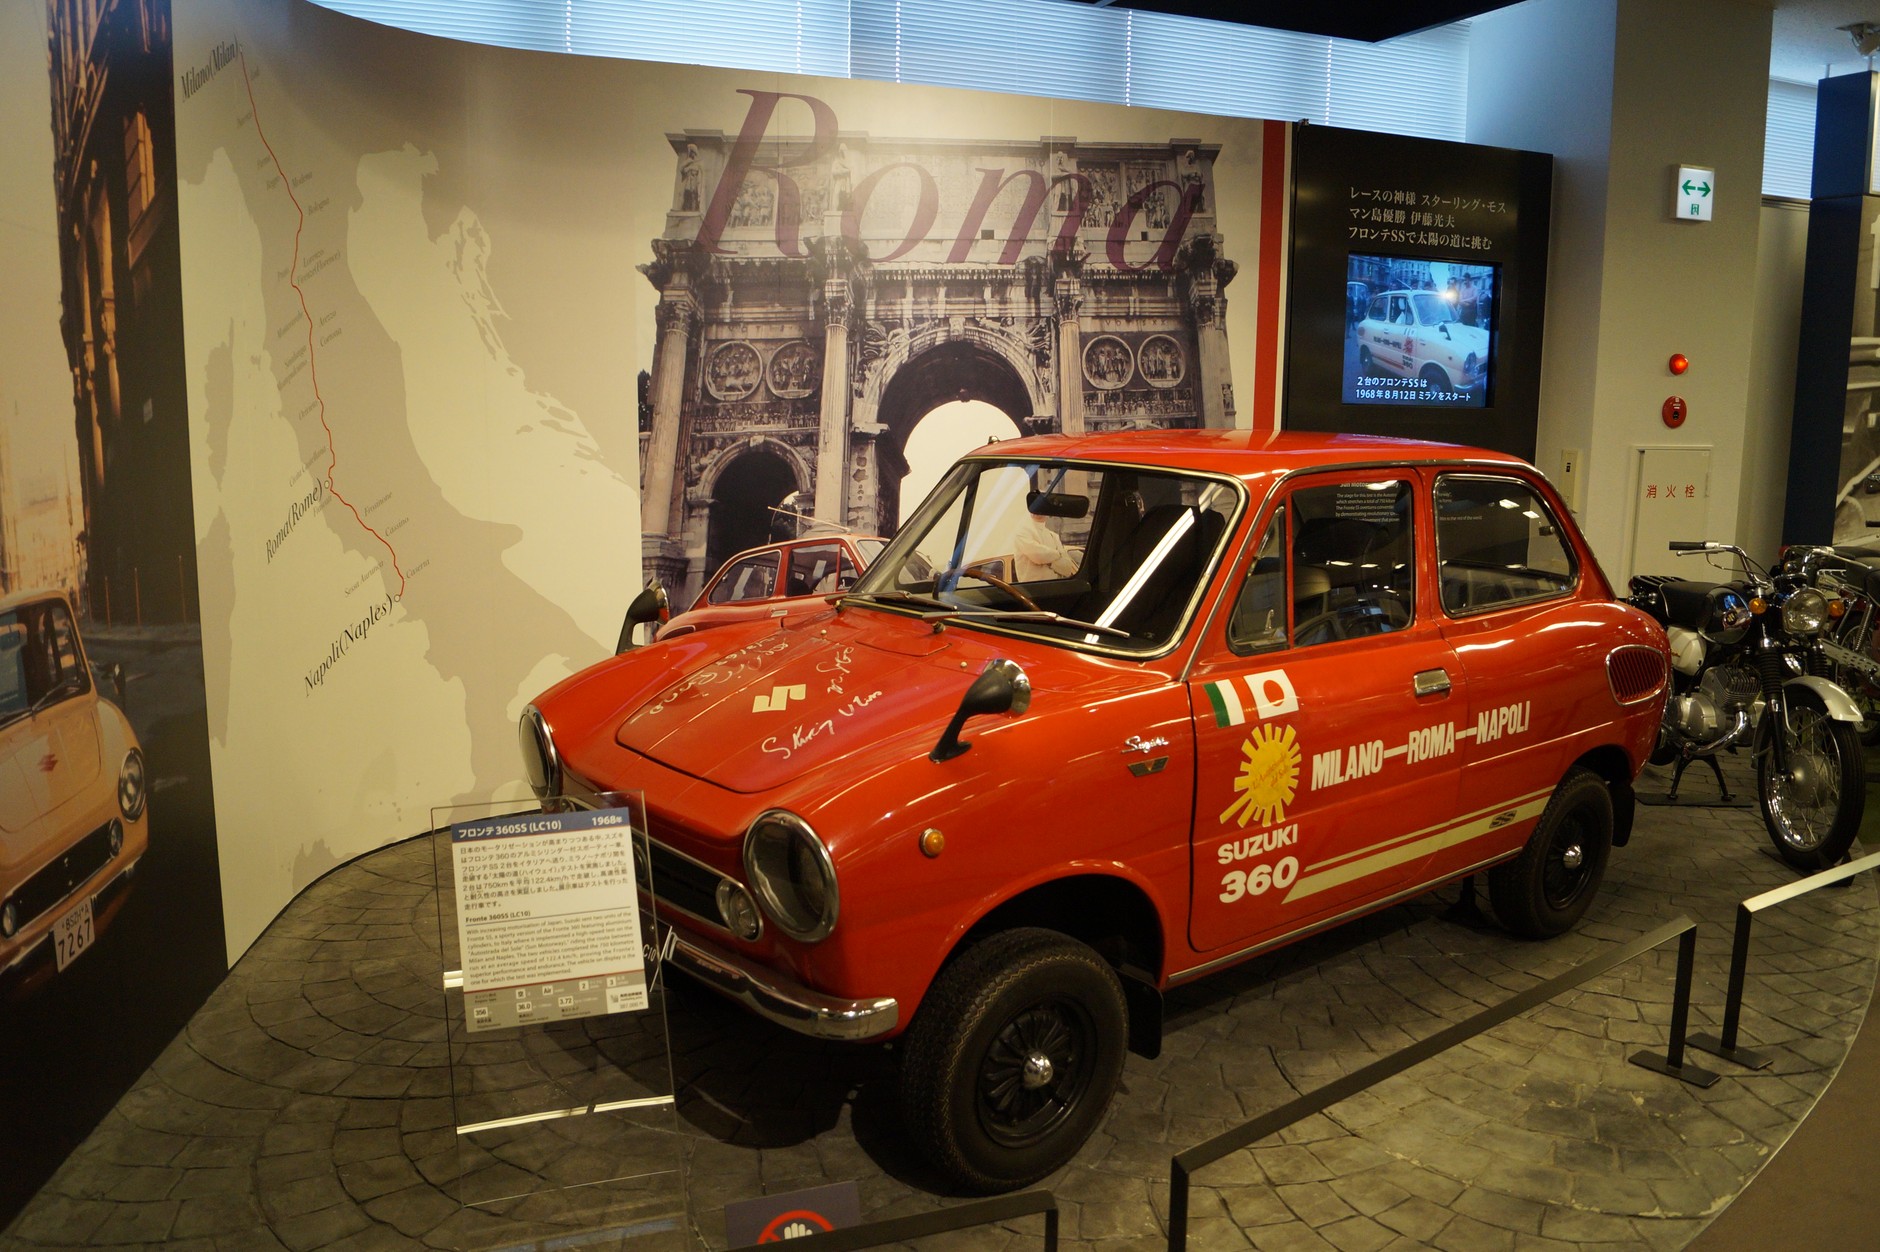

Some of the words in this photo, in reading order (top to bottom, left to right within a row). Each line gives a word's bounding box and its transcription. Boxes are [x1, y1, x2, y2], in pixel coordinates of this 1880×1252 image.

[181, 32, 240, 103] Milano(Milan)
[694, 87, 1205, 273] Roma
[1350, 187, 1416, 205] レースの神様
[1421, 195, 1506, 214] スターリング・モス
[1350, 207, 1406, 224] マン島優勝
[1411, 211, 1455, 228] 伊藤光夫
[1348, 226, 1491, 250] フロンテSSで太陽の道に挑む
[1355, 388, 1416, 400] 1968年8月12日
[1417, 391, 1471, 402] ミラノをスタート
[1357, 376, 1428, 388] 2台のフロンテSSは
[1645, 483, 1696, 499] 消火栓
[265, 477, 323, 565] Roma(Rome)
[304, 593, 394, 698] Napoli(Naples)
[529, 819, 561, 832] (LC10)
[1217, 824, 1298, 865] SUZUKI
[1219, 856, 1299, 903] 360
[465, 915, 487, 923] Fronte
[488, 912, 508, 920] 360SS
[510, 910, 530, 918] (LC10)
[57, 918, 90, 965] 7267
